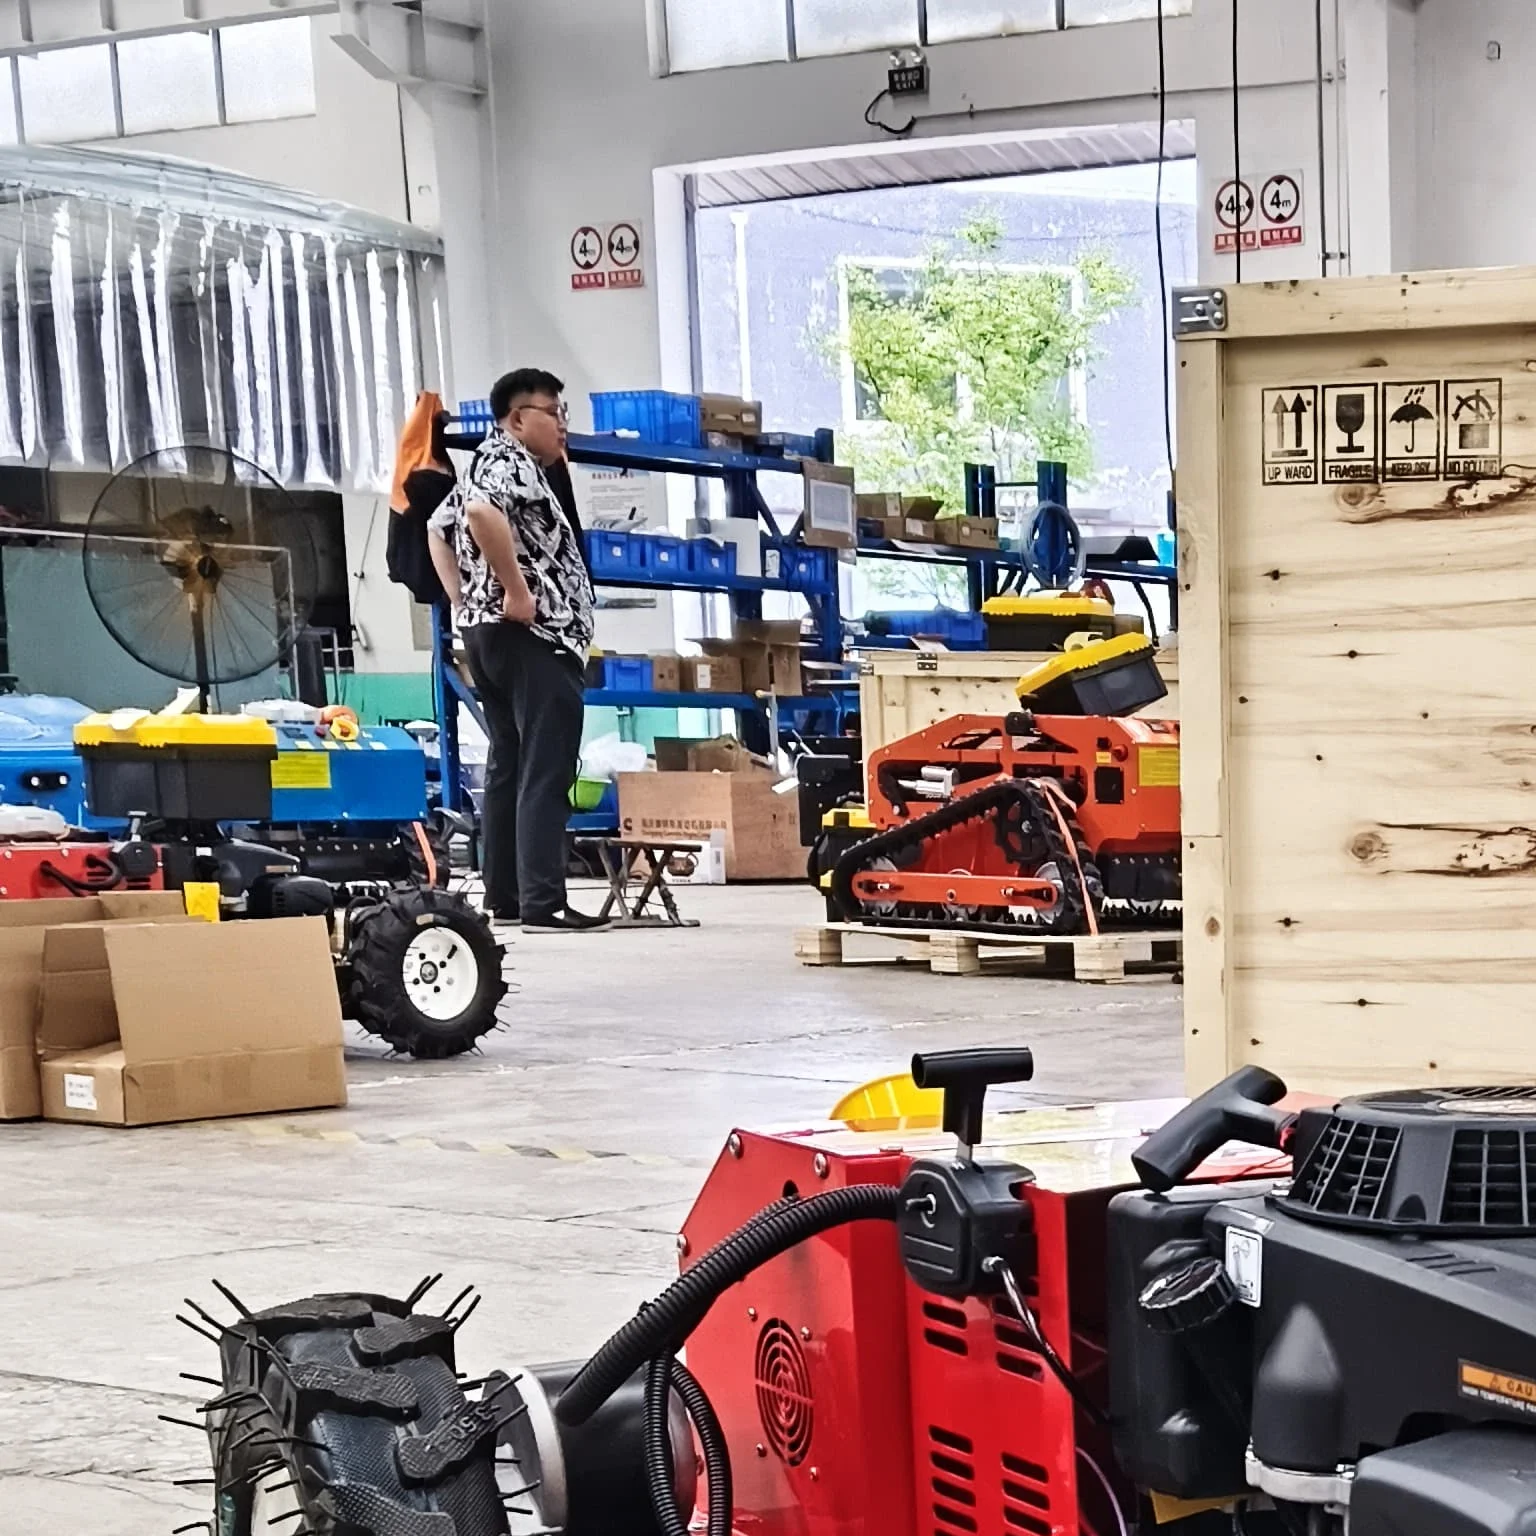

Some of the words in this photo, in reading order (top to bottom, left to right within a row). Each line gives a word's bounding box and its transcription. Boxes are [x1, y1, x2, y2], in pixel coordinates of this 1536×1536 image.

[1268, 466, 1282, 480] UP
[1284, 465, 1312, 479] WARD
[1328, 464, 1373, 479] FRAGILE
